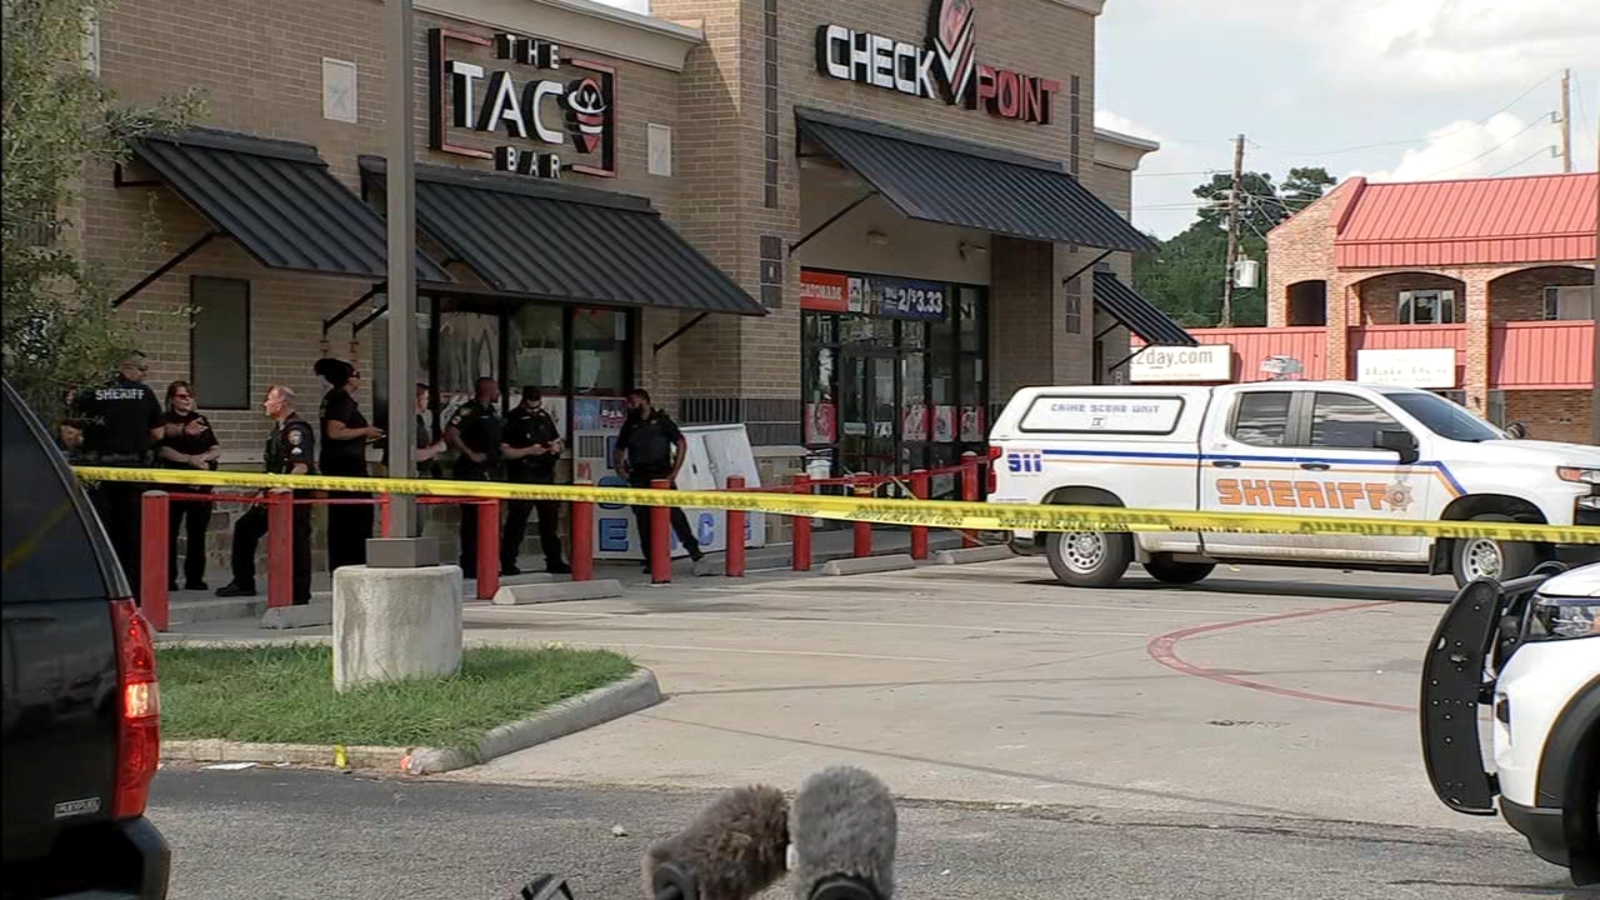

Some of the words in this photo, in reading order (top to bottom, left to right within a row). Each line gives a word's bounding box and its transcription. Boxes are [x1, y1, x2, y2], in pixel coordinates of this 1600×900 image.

[500, 33, 560, 70] THE
[822, 24, 936, 99] CHECK
[974, 64, 1068, 125] POINT
[500, 145, 561, 179] BAR
[95, 388, 145, 401] SHERIFF
[1051, 403, 1086, 413] CRIME
[1090, 404, 1128, 413] SCENE
[1133, 404, 1161, 414] UNIT
[1215, 478, 1391, 511] SHERIFF
